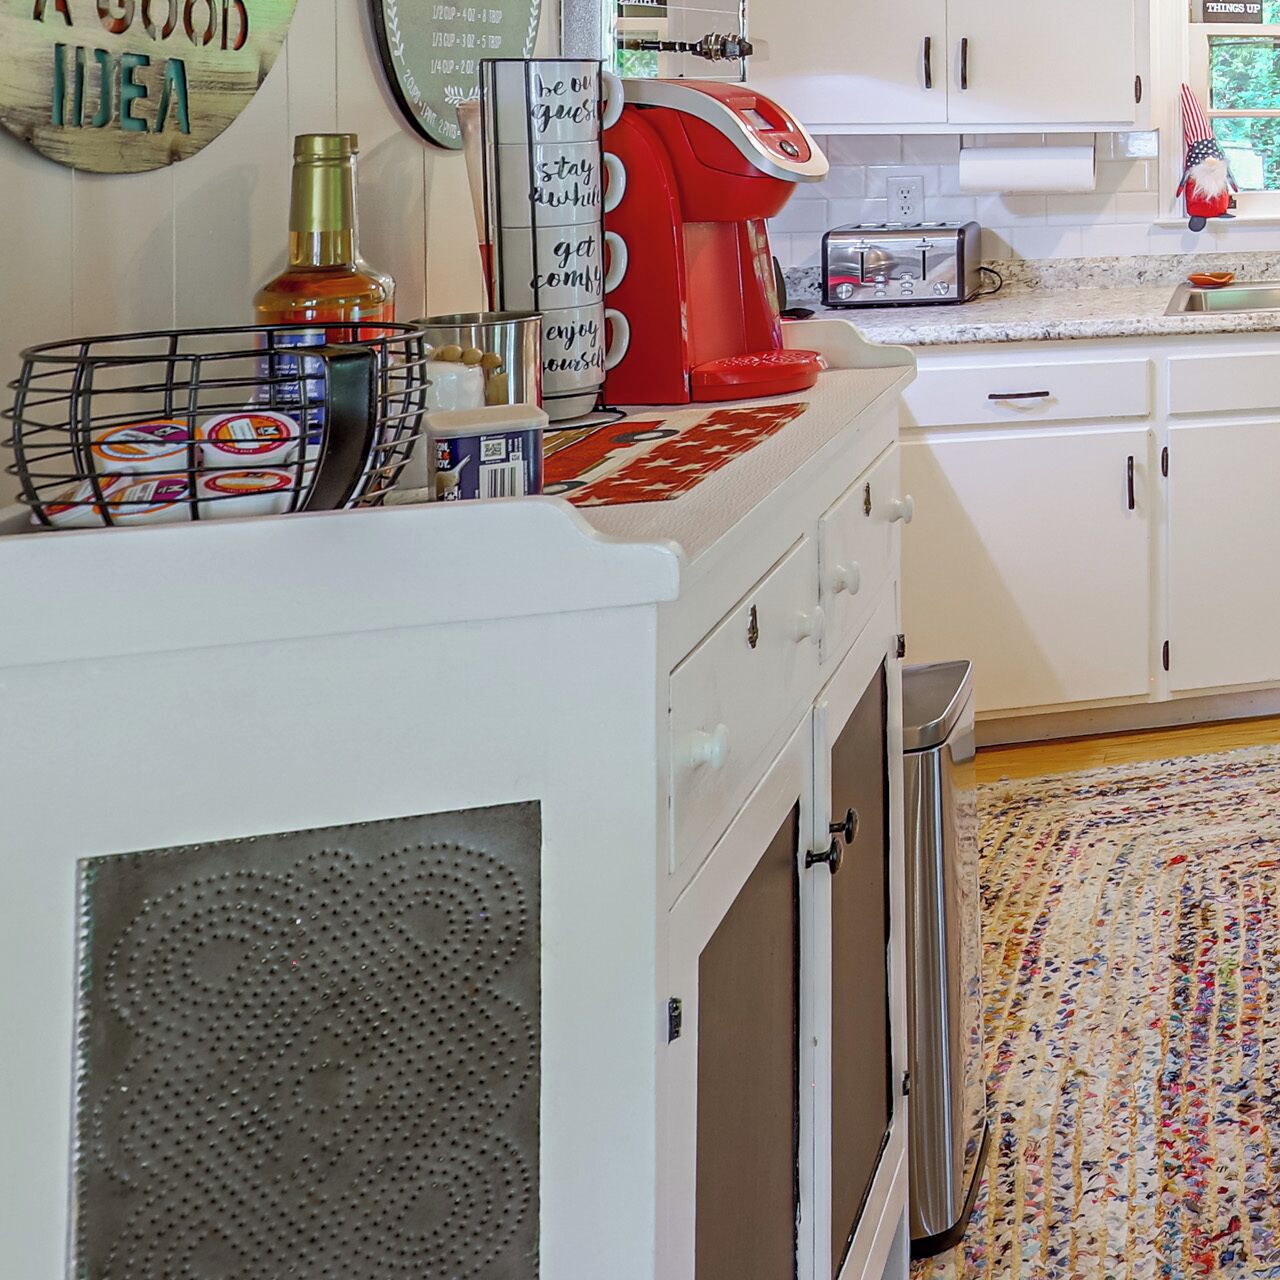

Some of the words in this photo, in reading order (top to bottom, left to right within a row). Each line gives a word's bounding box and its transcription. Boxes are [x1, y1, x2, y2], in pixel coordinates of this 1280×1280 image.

[1206, 2, 1245, 13] THINGS
[1246, 3, 1261, 14] UP
[51, 43, 190, 135] IDEA
[534, 73, 568, 98] be
[536, 155, 595, 186] stay
[553, 235, 596, 269] get
[530, 264, 602, 296] comfy
[546, 320, 600, 351] enjoy
